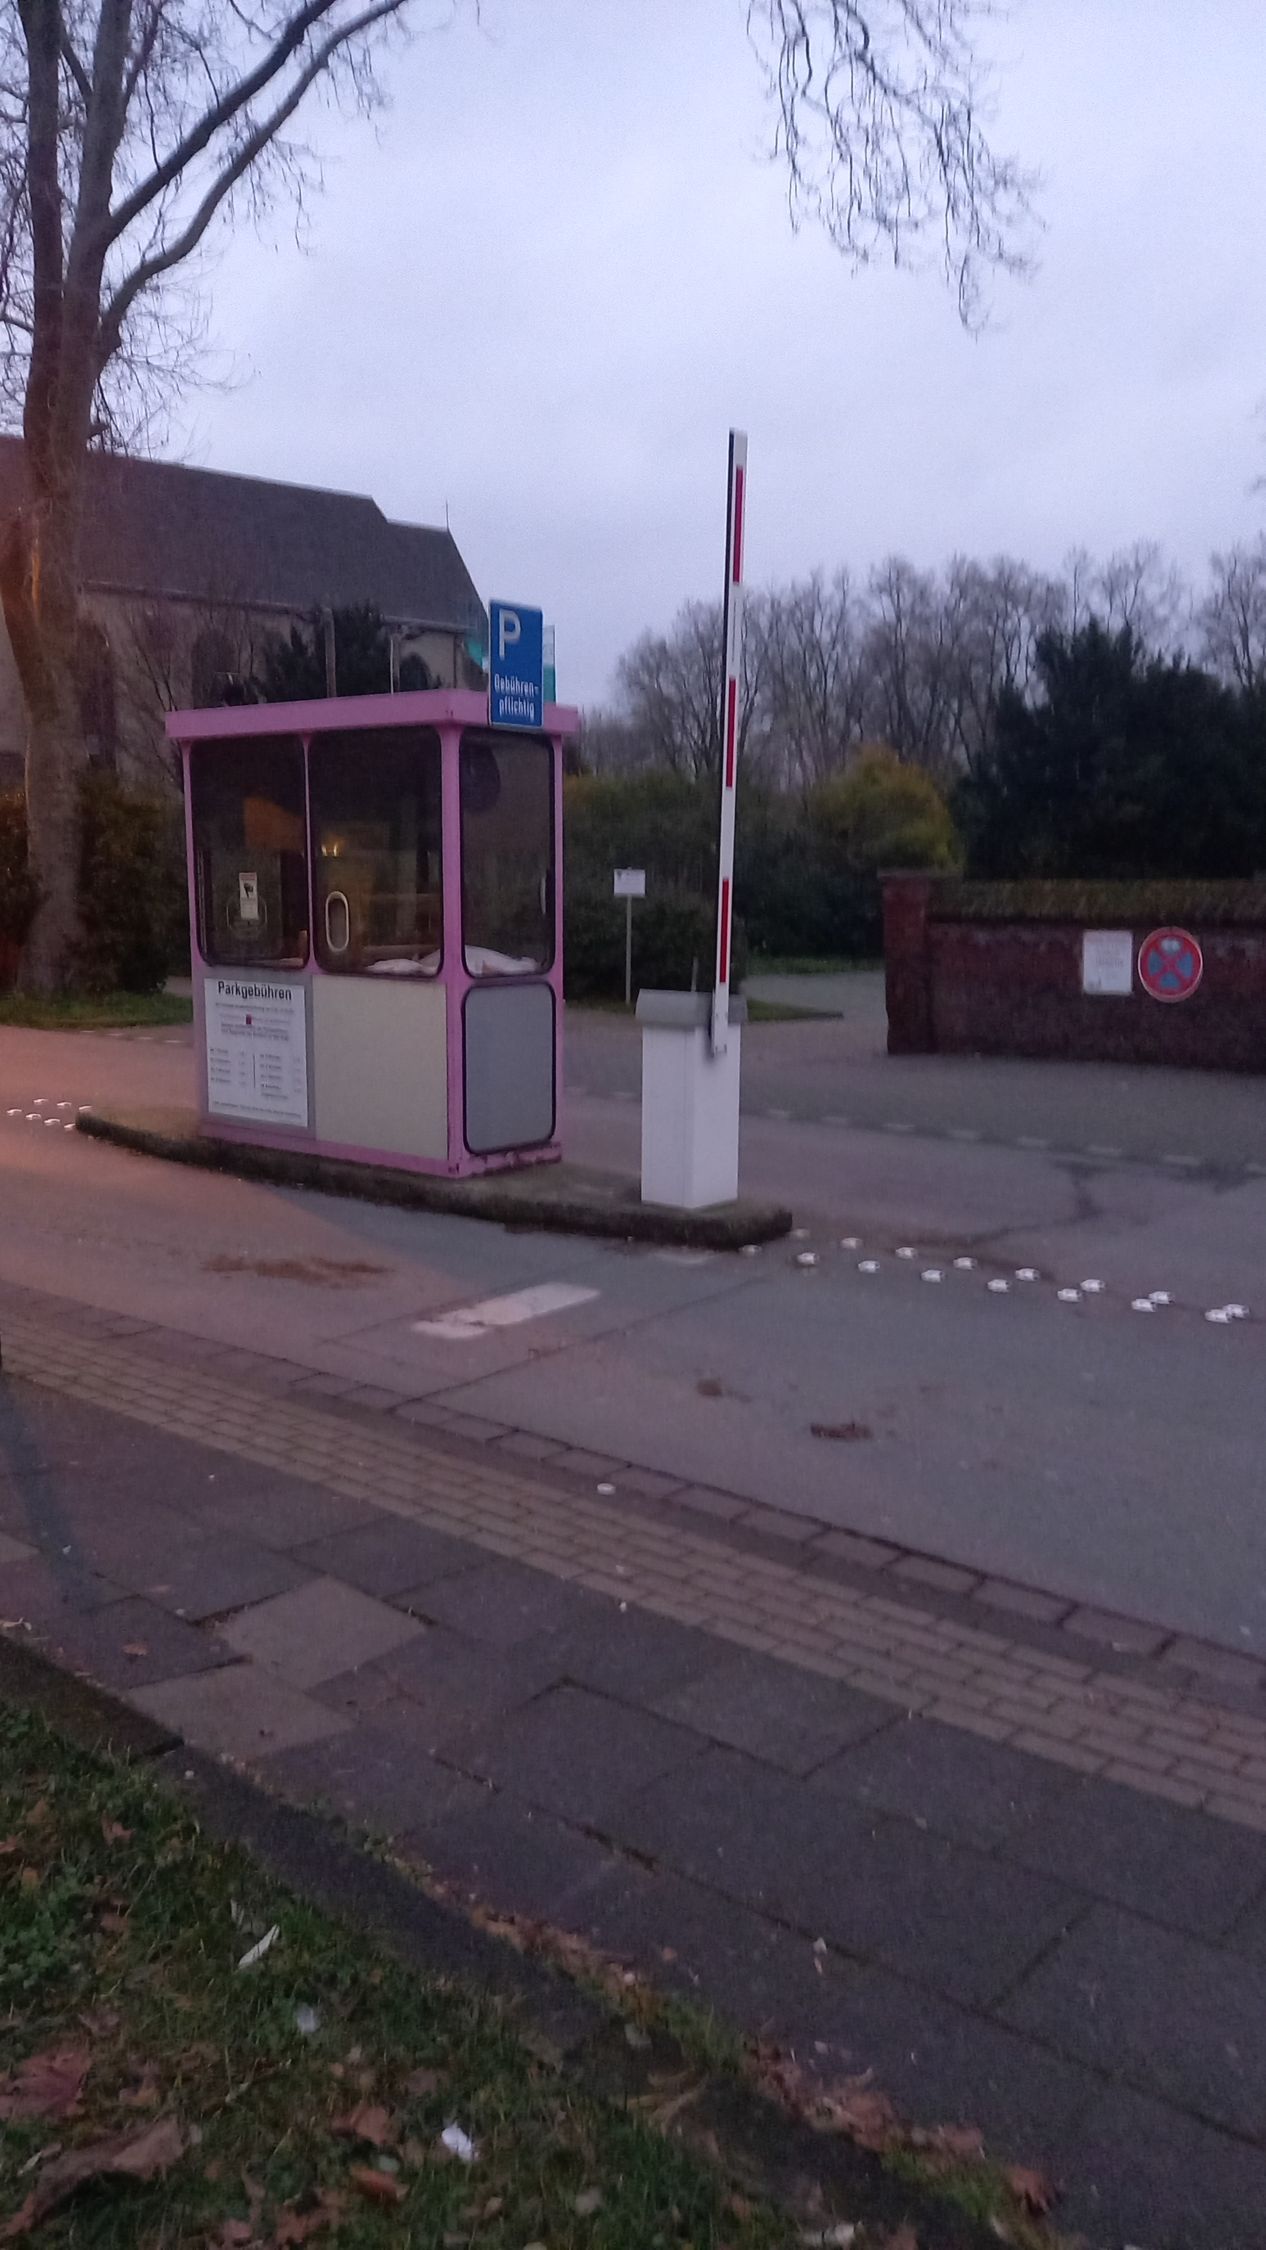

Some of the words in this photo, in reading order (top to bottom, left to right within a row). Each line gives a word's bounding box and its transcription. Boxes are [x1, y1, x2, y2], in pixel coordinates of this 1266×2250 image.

[499, 608, 521, 660] P
[494, 673, 540, 697] Gebühren-
[499, 695, 535, 722] pflichtig
[217, 980, 292, 1000] Parkgebühren
